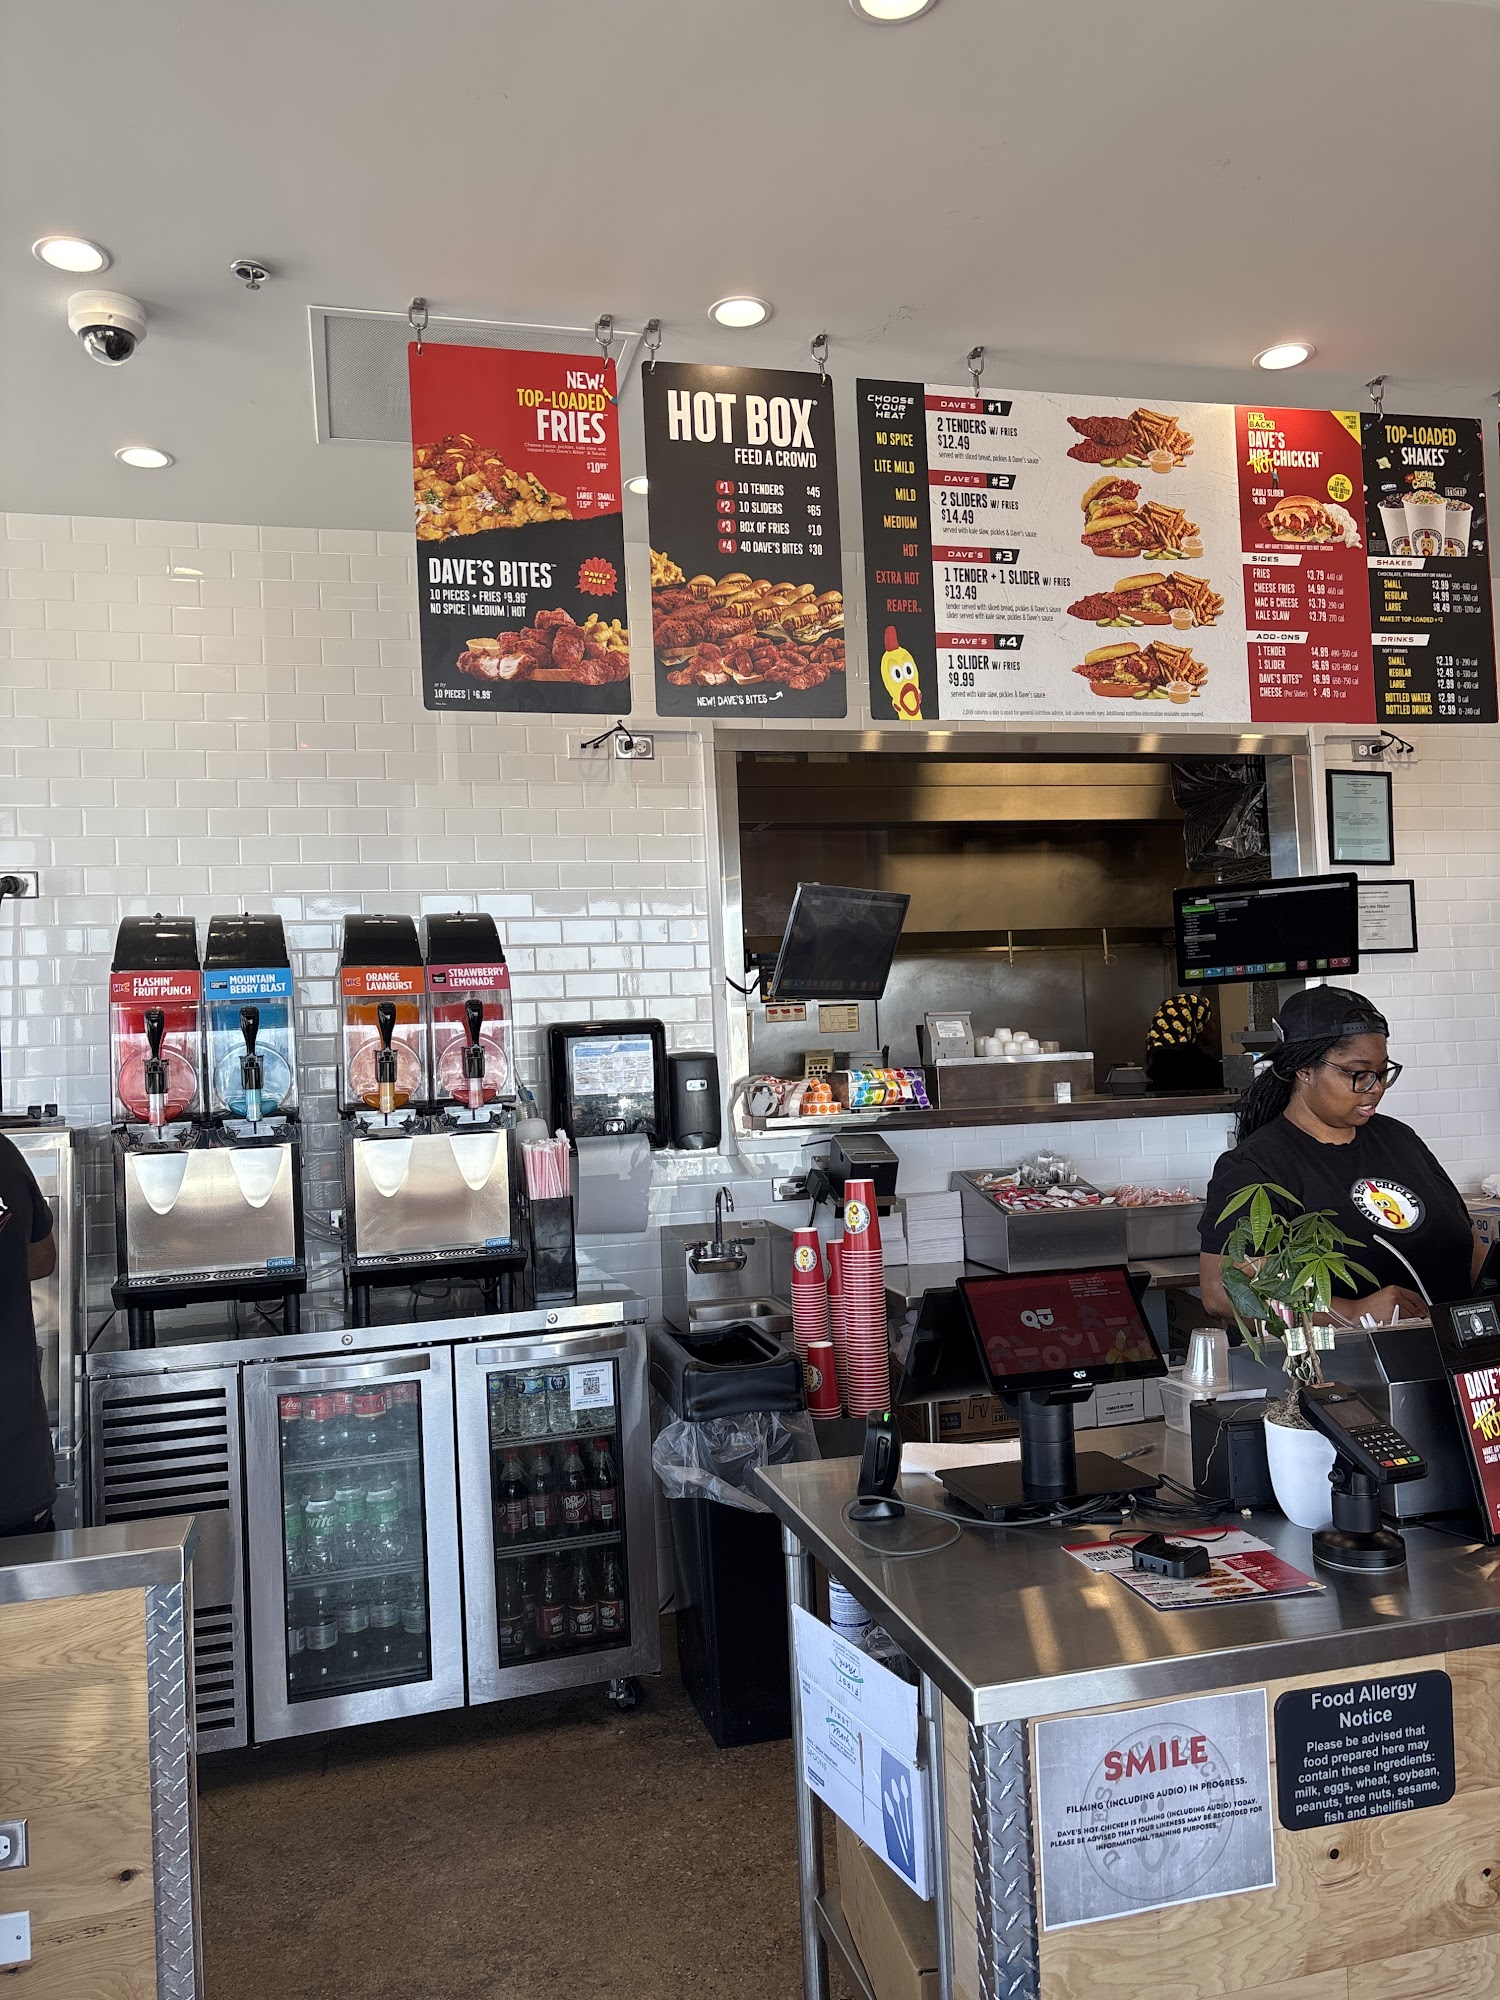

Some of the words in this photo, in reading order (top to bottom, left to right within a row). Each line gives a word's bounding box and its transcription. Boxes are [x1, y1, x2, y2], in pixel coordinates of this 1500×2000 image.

[566, 370, 604, 390] NEW!
[517, 388, 606, 411] TOP-LOADED
[867, 394, 914, 404] CHOOSE
[875, 403, 906, 412] YOUR
[941, 401, 976, 409] DAVE'S
[988, 403, 1002, 413] #1
[668, 390, 736, 443] HOT
[746, 395, 815, 448] BOX
[876, 411, 905, 419] HEAT
[937, 417, 943, 432] 2
[946, 418, 987, 434] TENDERS
[989, 426, 998, 435] W/
[1001, 427, 1018, 437] FRIES
[876, 432, 887, 446] NO
[890, 432, 914, 447] SPICE
[938, 434, 970, 450] $12.49
[1248, 431, 1285, 449] DAVE'S
[1385, 425, 1456, 446] TOP-LOADED
[735, 448, 762, 465] FEED
[766, 451, 773, 465] A
[776, 451, 817, 468] CROWD
[1273, 451, 1319, 468] CHICKEN
[1402, 447, 1445, 467] SHAKES
[874, 459, 892, 473] LITE
[894, 460, 915, 474] MILD
[944, 475, 979, 483] DAVE'S
[991, 476, 1010, 487] #2
[577, 492, 593, 500] LARGE
[598, 493, 615, 501] SMALL
[738, 482, 749, 494] 10
[750, 483, 784, 496] TENDERS
[807, 486, 820, 498] $45
[941, 491, 947, 506] 2
[950, 492, 988, 508] SLIDERS
[990, 500, 999, 509] W/
[1002, 500, 1019, 510] FRIES
[739, 501, 749, 513] 10
[751, 501, 783, 514] SLIDERS
[807, 505, 821, 517] $65
[942, 509, 974, 524] $14.49
[740, 521, 755, 533] BOX
[757, 522, 766, 534] OF
[768, 522, 790, 535] FRIES
[808, 524, 822, 536] $10
[883, 515, 918, 529] MEDIUM
[429, 558, 495, 586] DAVE'S
[500, 561, 552, 589] BITES
[584, 570, 611, 580] DAVE'S
[876, 570, 902, 584] EXTRA
[904, 572, 920, 585] HOT
[1253, 568, 1270, 578] FRIES
[1307, 570, 1324, 580] $3.79
[430, 589, 440, 600] 10
[442, 589, 470, 601] PIECES
[479, 592, 501, 602] FRIES
[1255, 597, 1269, 608] MAC
[1276, 598, 1299, 608] CHEESE
[430, 603, 442, 614] NO
[443, 604, 466, 615] SPICE
[473, 605, 505, 616] MEDIUM
[511, 606, 526, 617] HOT
[1256, 610, 1270, 620] KALE
[1272, 610, 1290, 621] SLAW
[697, 696, 716, 707] NEW!
[718, 695, 744, 706] DAVE'S
[746, 694, 768, 705] BITES
[1385, 693, 1410, 703] BOTTLED
[1411, 693, 1431, 703] WATER
[1438, 693, 1455, 703] $2.99
[230, 974, 275, 985] MOUNTAIN
[366, 972, 400, 981] ORANGE
[448, 967, 504, 977] STRAWBERRY
[133, 976, 174, 987] FLASHIN'
[230, 984, 258, 994] BERRY
[260, 982, 286, 992] BLAST
[366, 981, 413, 990] LAVABURST
[450, 977, 495, 987] LEMONADE
[133, 987, 159, 997] FRUIT
[161, 985, 192, 996] PUNCH
[1375, 1181, 1420, 1209] CHICKEN
[1477, 1220, 1488, 1230] 90
[1311, 1688, 1354, 1710] Food
[1359, 1682, 1417, 1703] Allergy
[830, 1706, 849, 1727] FIRST
[1339, 1708, 1393, 1729] Notice
[1307, 1739, 1343, 1753] Please
[1346, 1736, 1359, 1746] be
[1362, 1728, 1402, 1744] advised
[1405, 1725, 1425, 1737] that
[1104, 1735, 1208, 1780] SMILE
[1303, 1755, 1328, 1768] food
[1331, 1746, 1378, 1765] prepared
[1382, 1743, 1405, 1755] here
[1407, 1739, 1430, 1751] may
[1298, 1769, 1338, 1784] contain
[1341, 1764, 1370, 1776] these
[1373, 1753, 1436, 1773] ingredients:
[1295, 1786, 1321, 1799] milk,
[1324, 1782, 1353, 1796] eggs,
[1356, 1774, 1390, 1789] wheat,
[1393, 1767, 1440, 1784] soybean,
[1066, 1802, 1103, 1814] FILMING
[1106, 1791, 1155, 1809] (INCLUDING
[1156, 1784, 1187, 1798] AUDIO)
[1190, 1783, 1198, 1792] IN
[1201, 1777, 1247, 1790] PROGRESS.
[1296, 1798, 1342, 1816] peanuts,
[1345, 1794, 1365, 1805] tree
[1369, 1788, 1395, 1802] nuts,
[1398, 1781, 1440, 1795] sesame,
[1057, 1829, 1082, 1837] DAVE'S
[1101, 1821, 1129, 1832] CHICKEN
[1138, 1813, 1165, 1824] FILMING
[1167, 1805, 1205, 1819] (INCLUDING
[1207, 1801, 1231, 1811] AUDIO)
[1234, 1798, 1257, 1806] TODAY.
[1324, 1812, 1344, 1823] fish
[1347, 1806, 1367, 1819] and
[1370, 1798, 1414, 1816] shellfish
[1050, 1838, 1075, 1848] PLEASE
[1087, 1833, 1116, 1842] ADVISED
[1118, 1829, 1134, 1837] THAT
[1136, 1824, 1157, 1834] YOUR
[1156, 1817, 1185, 1829] LIKENESS
[1187, 1815, 1201, 1823] MAY
[1213, 1809, 1248, 1819] RECORDED
[1096, 1827, 1181, 1850] INFORMATIONAL/TRAINING
[1183, 1822, 1219, 1833] PURPOSES.
